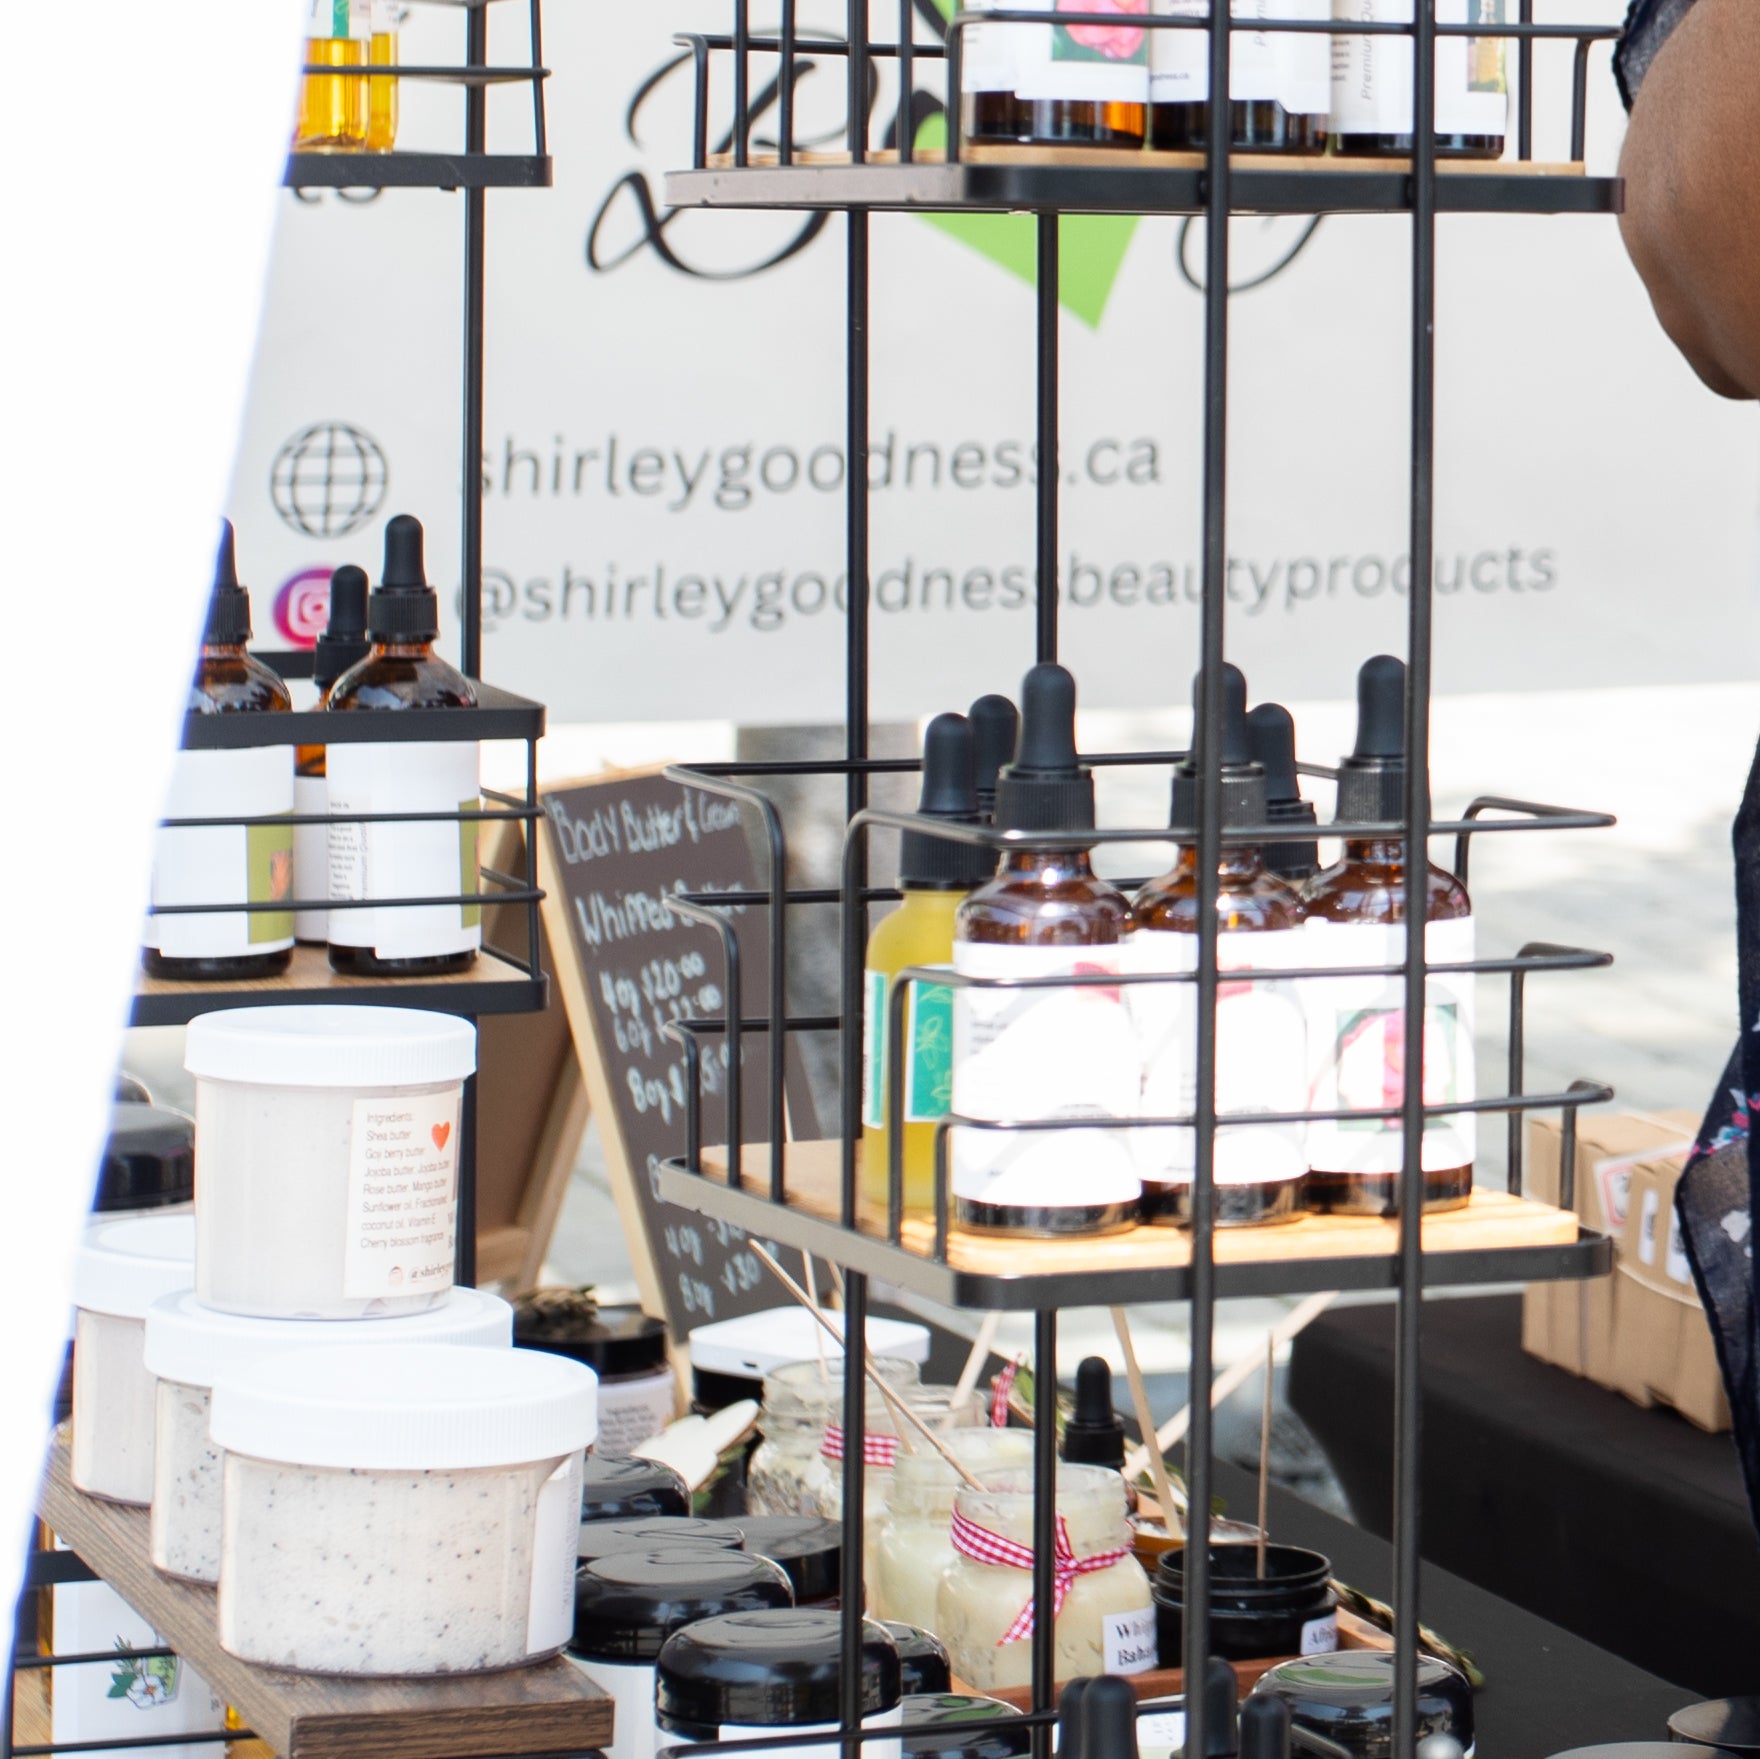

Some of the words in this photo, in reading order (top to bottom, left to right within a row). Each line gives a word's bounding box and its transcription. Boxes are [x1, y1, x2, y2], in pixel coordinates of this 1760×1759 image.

[455, 545, 1559, 635] @shirleygoodnesbeautyproucts
[549, 795, 621, 865] Body
[362, 1200, 402, 1212] Sunflower
[361, 1219, 394, 1231] coconut
[360, 1237, 389, 1250] Cherry
